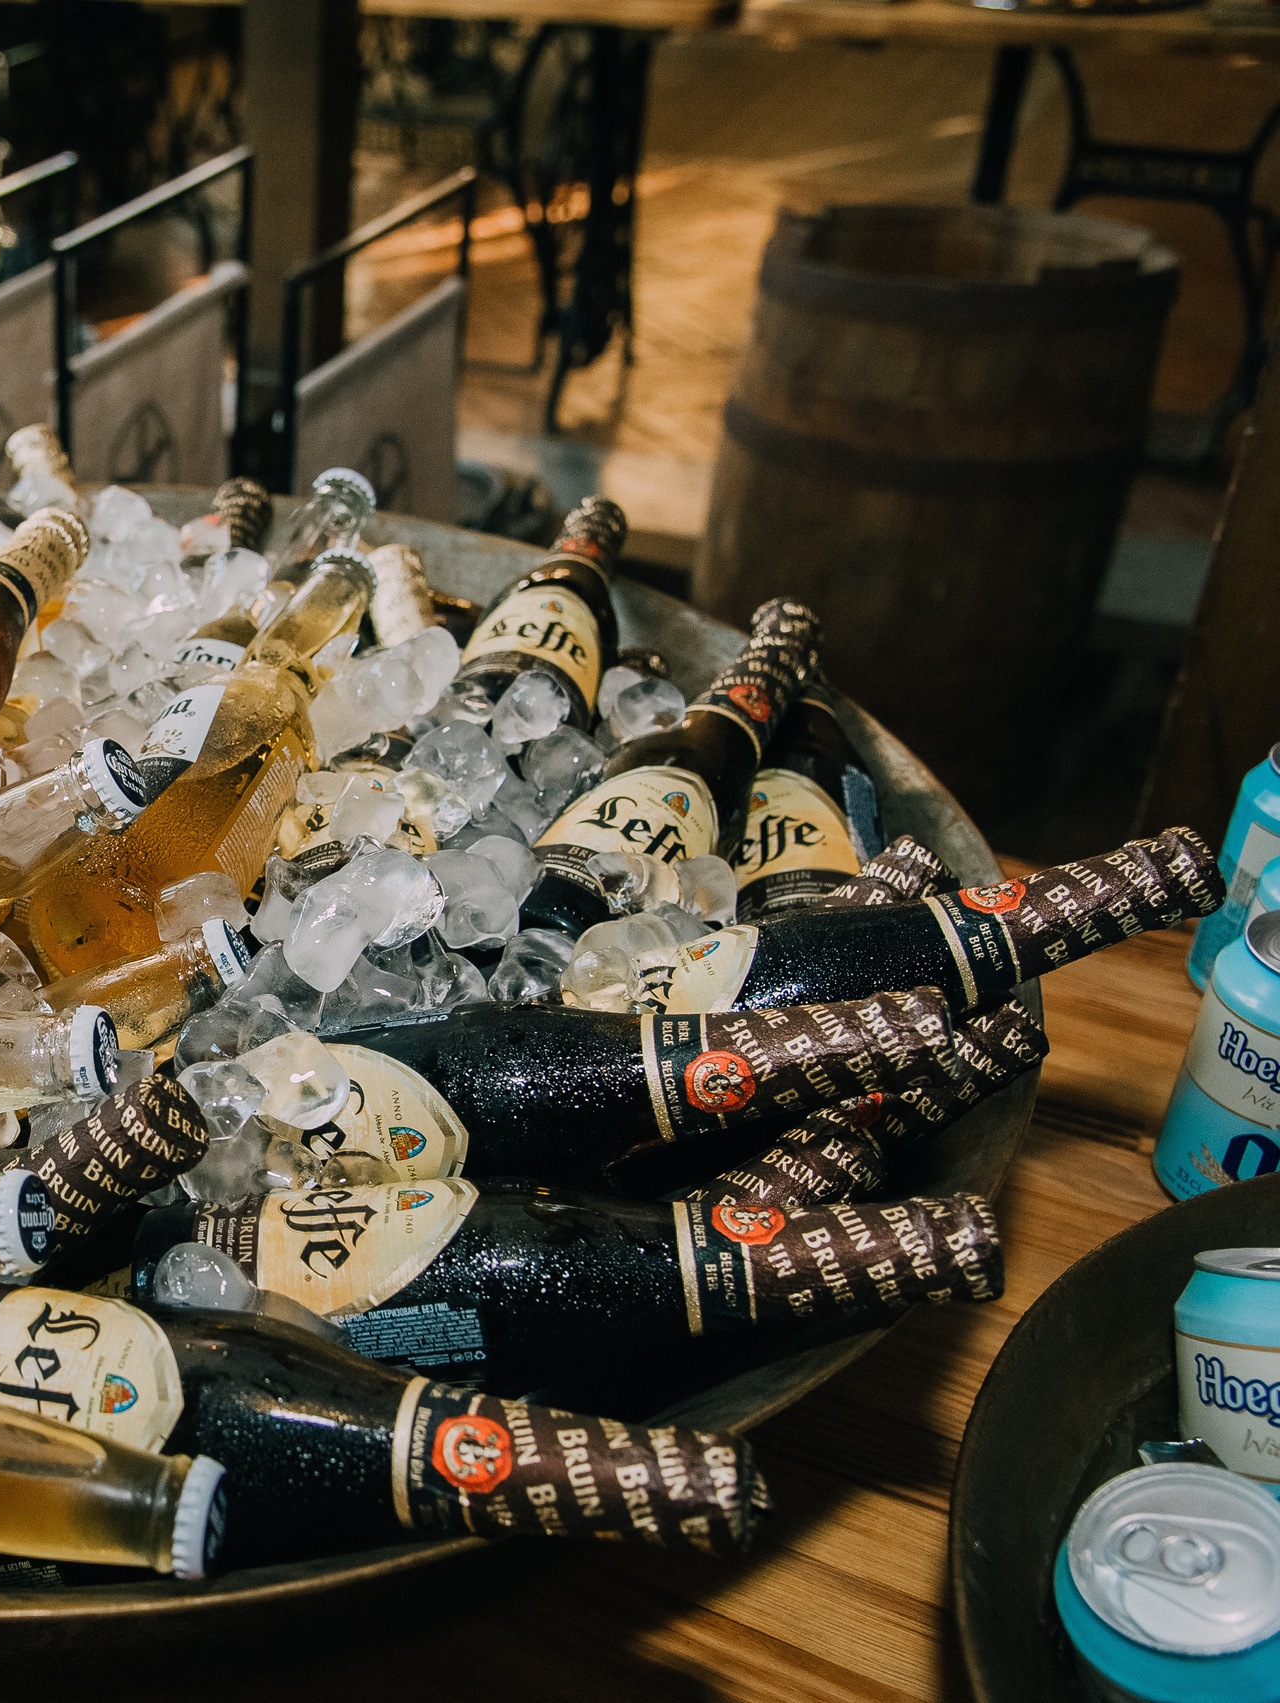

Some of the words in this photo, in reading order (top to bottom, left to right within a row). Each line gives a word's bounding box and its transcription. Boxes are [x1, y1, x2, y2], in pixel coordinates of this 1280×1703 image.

[575, 796, 686, 864] Leff
[734, 815, 828, 874] effe
[1058, 862, 1113, 897] RUIN
[391, 1088, 403, 1122] ANNO
[38, 1157, 101, 1214] BRUIN
[716, 1169, 773, 1201] RUIN
[20, 1206, 56, 1232] Corona
[239, 1216, 257, 1263] BRUIN
[279, 1190, 380, 1280] effe
[403, 1214, 414, 1235] 1240
[879, 1205, 937, 1280] BRUNE
[422, 1303, 435, 1314] БЕЗ
[557, 1427, 605, 1517] BRUIN
